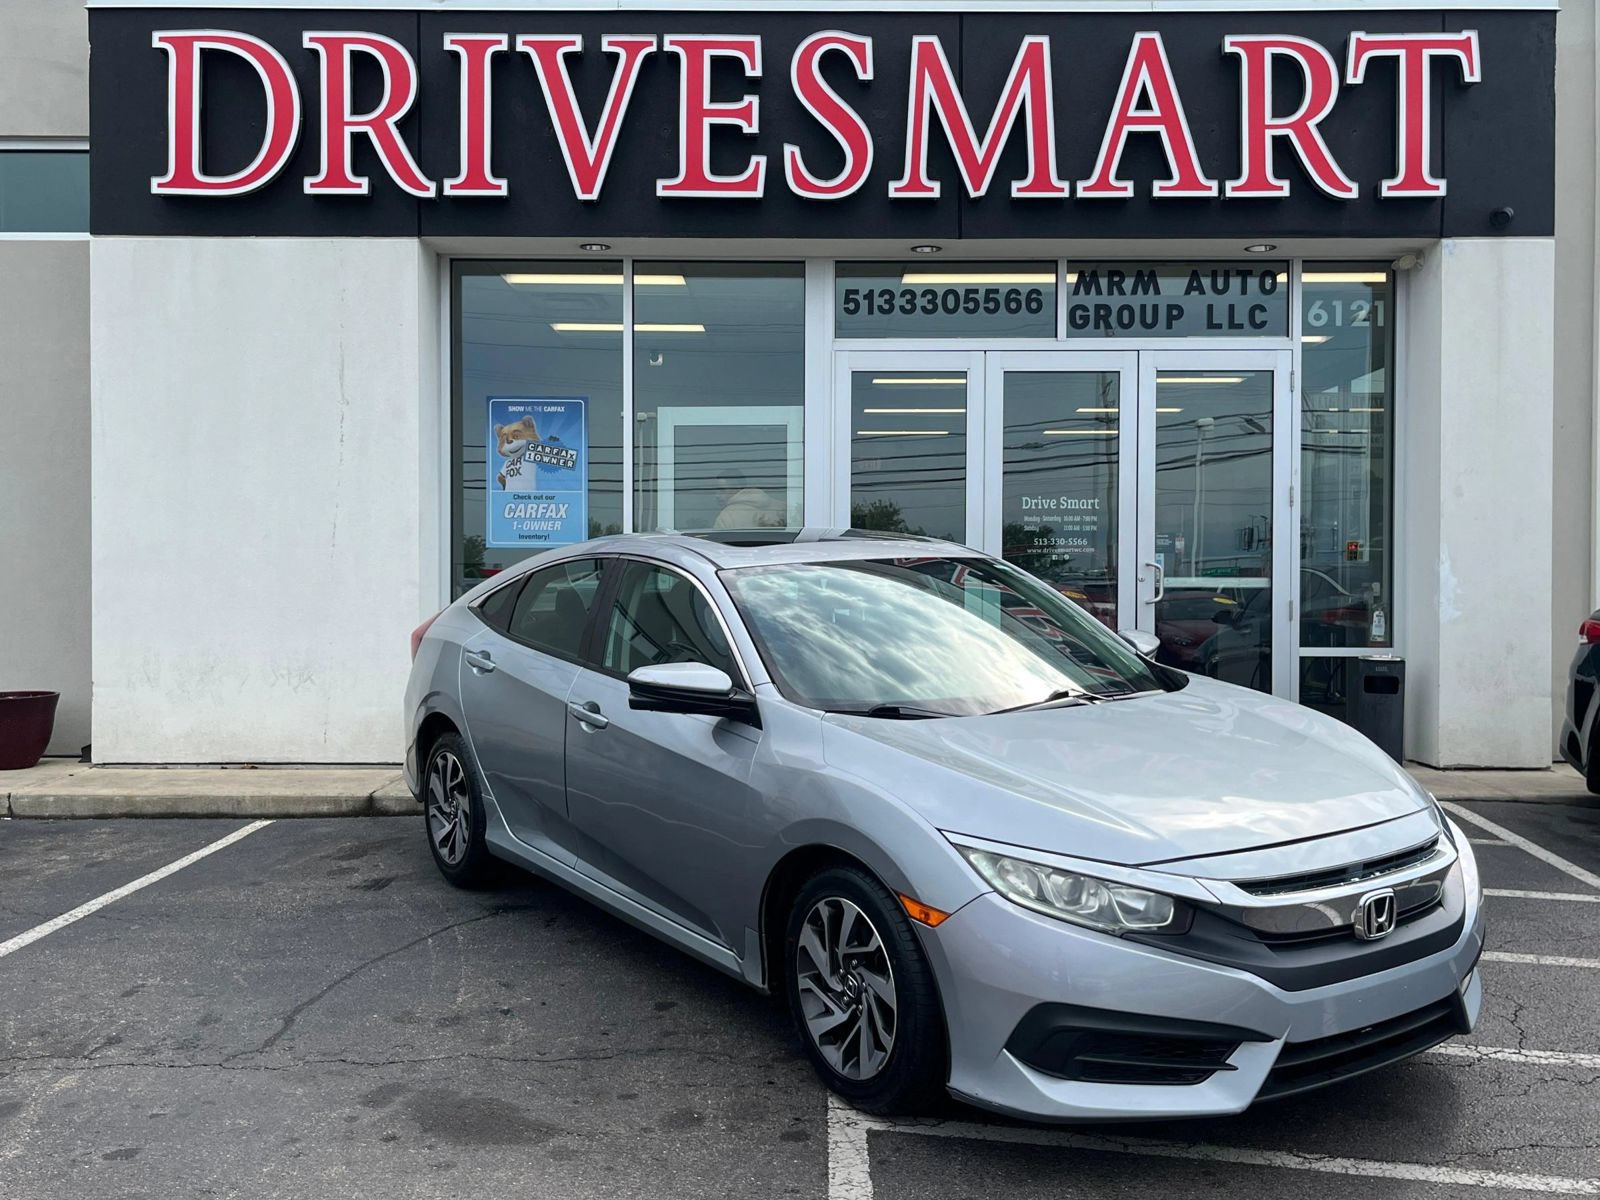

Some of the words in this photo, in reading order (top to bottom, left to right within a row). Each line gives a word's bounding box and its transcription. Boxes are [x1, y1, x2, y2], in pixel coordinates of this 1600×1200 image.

[150, 29, 1481, 201] DRIVESMART
[1072, 269, 1161, 296] MRM
[1184, 269, 1278, 296] AUTO
[843, 288, 1043, 315] 5133305566
[1069, 303, 1185, 330] GROUP
[1207, 303, 1268, 330] LLC
[1307, 299, 1385, 327] 6121
[528, 443, 576, 460] CARFAX
[505, 457, 522, 469] CAR
[505, 466, 522, 477] FOX
[1022, 496, 1057, 509] Drive
[1060, 496, 1100, 509] Smart
[504, 503, 569, 519] CARFAX
[512, 520, 562, 531] 1-OWNER
[1033, 538, 1088, 546] 513-330-5566
